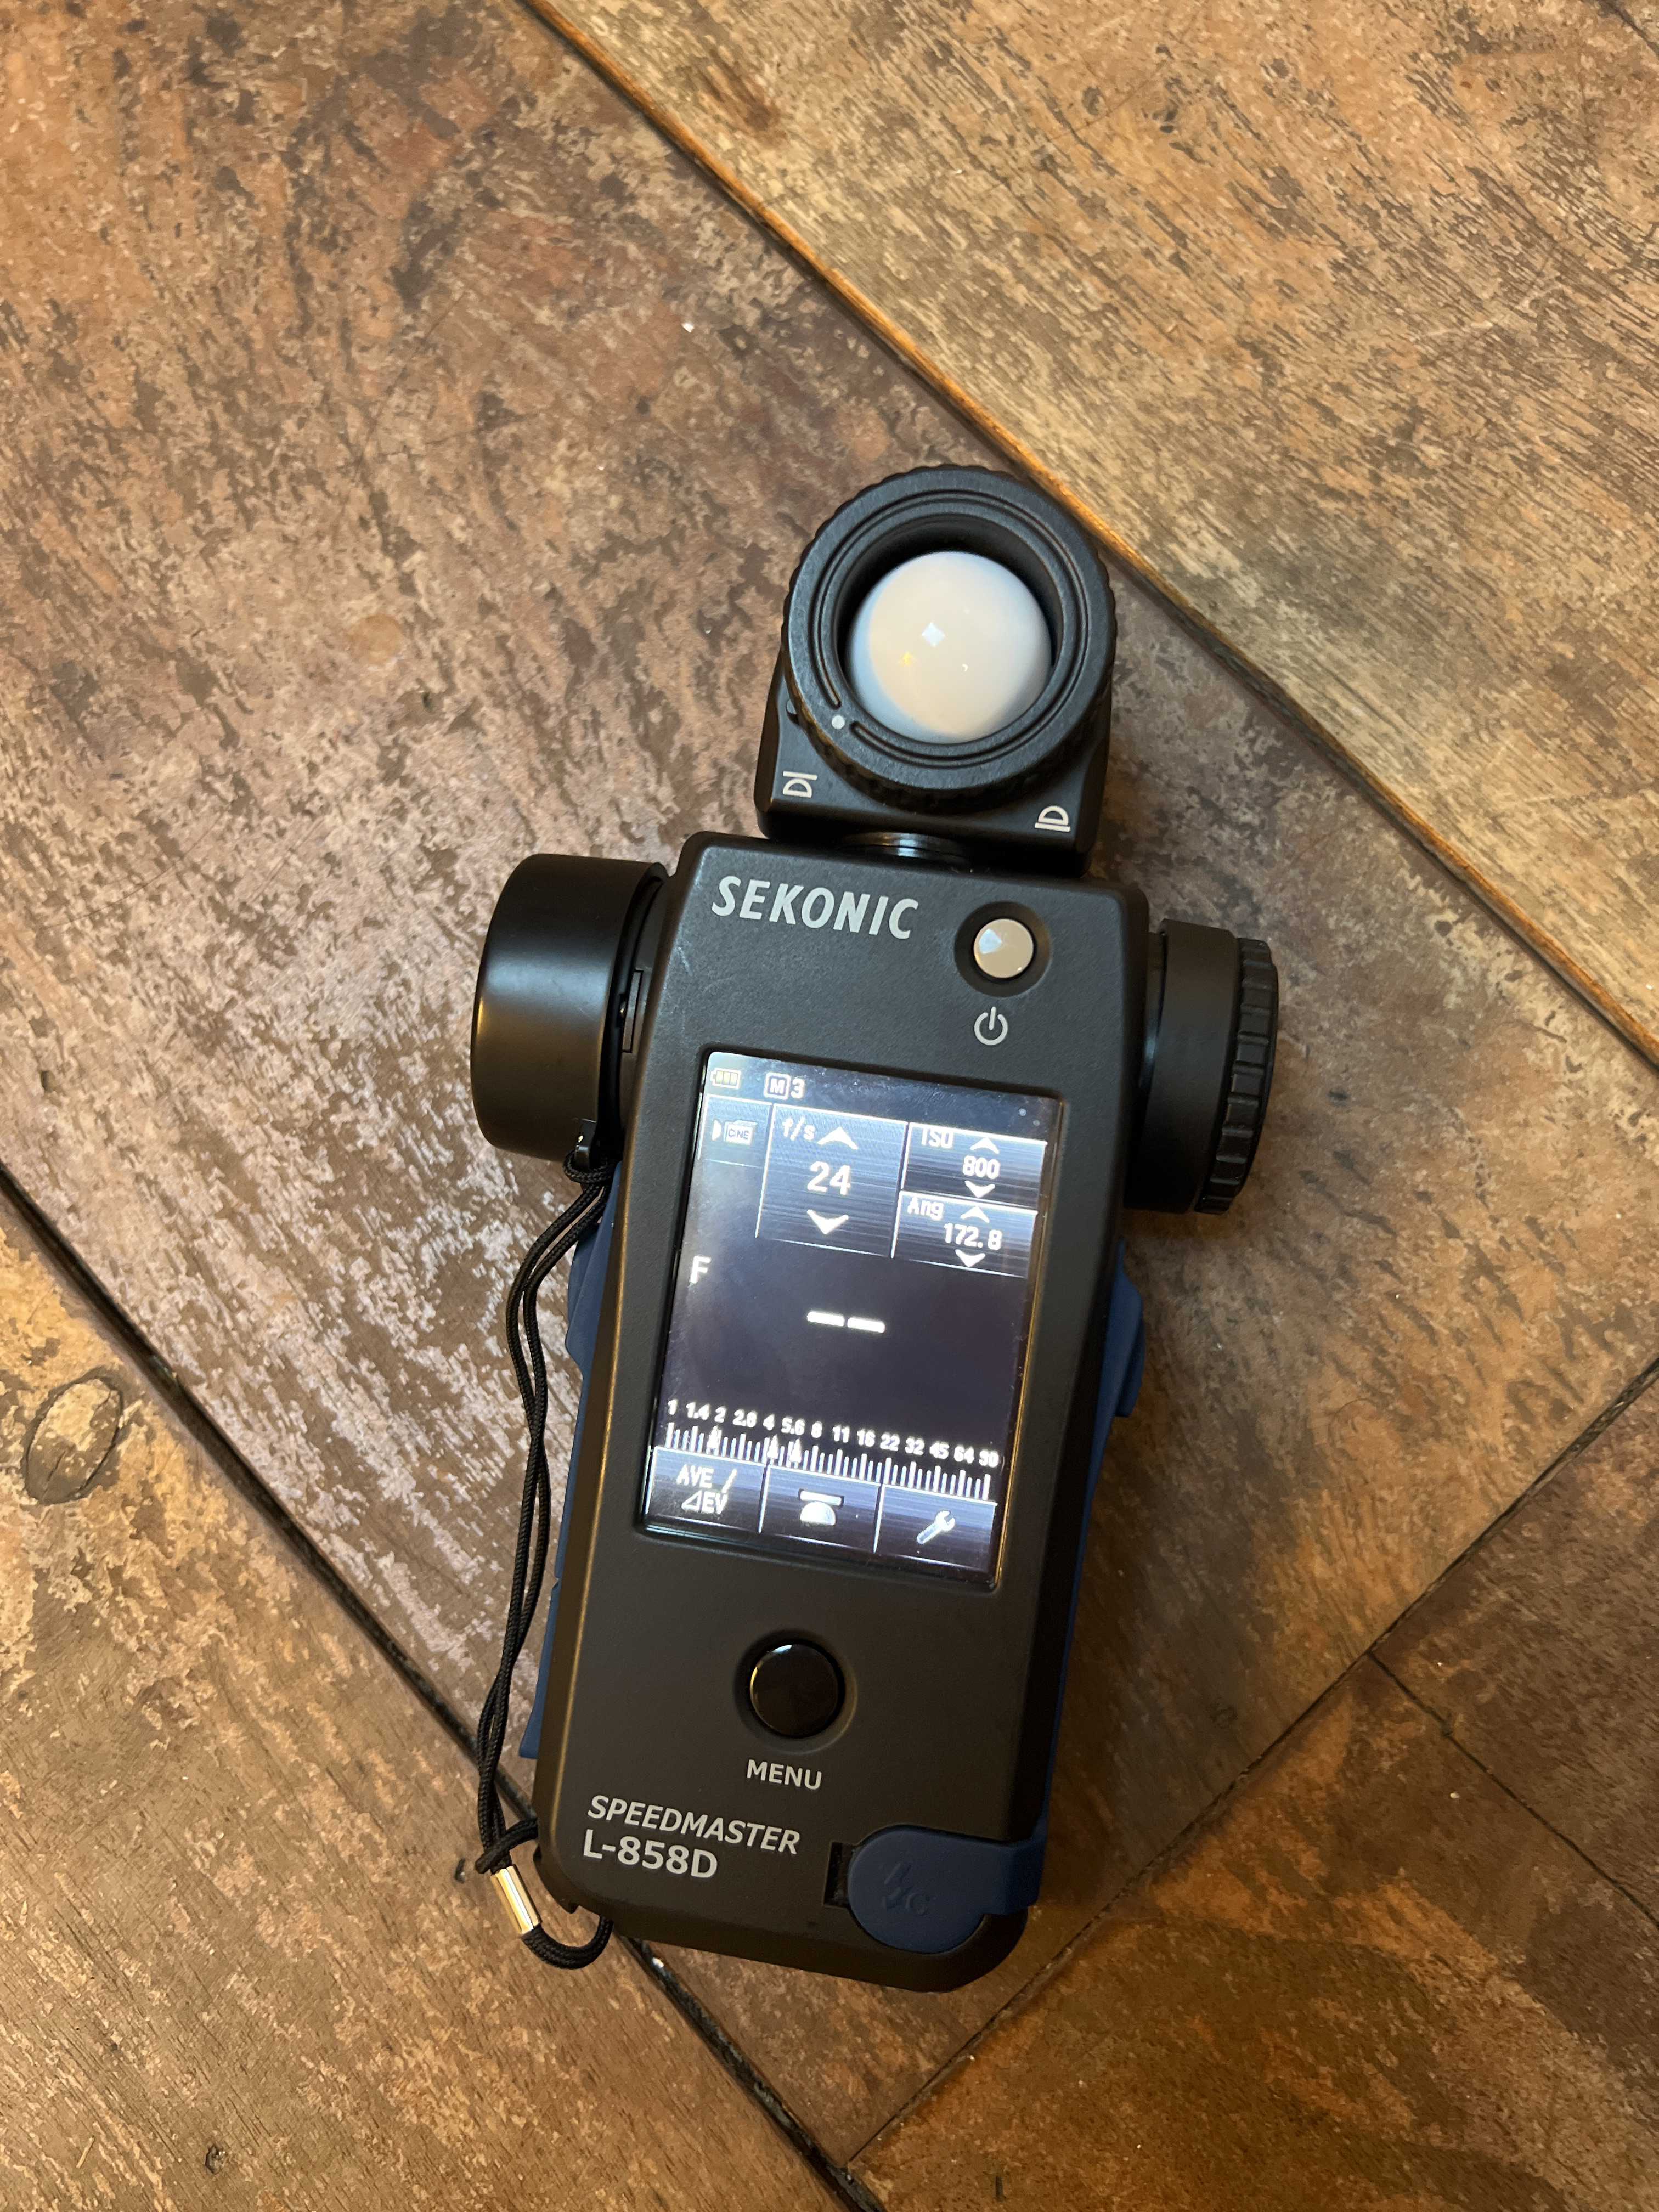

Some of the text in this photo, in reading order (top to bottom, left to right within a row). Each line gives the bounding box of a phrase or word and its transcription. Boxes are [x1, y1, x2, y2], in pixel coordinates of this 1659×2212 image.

[712, 876, 918, 939] SEKONIC
[921, 1127, 954, 1149] ISO
[808, 1161, 851, 1195] 24
[963, 1155, 1001, 1179] 800
[907, 1197, 944, 1221] Ang
[944, 1223, 1003, 1251] 172.8
[689, 1255, 711, 1284] F
[668, 1398, 678, 1415] 1
[686, 1401, 710, 1420] 1.4
[714, 1406, 726, 1423] 2
[732, 1408, 758, 1427] 2.8
[763, 1414, 775, 1431] 4
[781, 1416, 805, 1435] 5.6
[832, 1425, 850, 1443] 11
[857, 1429, 876, 1447] 16
[879, 1432, 900, 1451] 22
[905, 1436, 924, 1455] 32
[929, 1442, 949, 1459] 45
[953, 1445, 975, 1464] 64
[746, 1759, 822, 1791] MENU
[587, 1795, 801, 1855] SPEEDMASTER
[583, 1829, 718, 1879] L-858D
